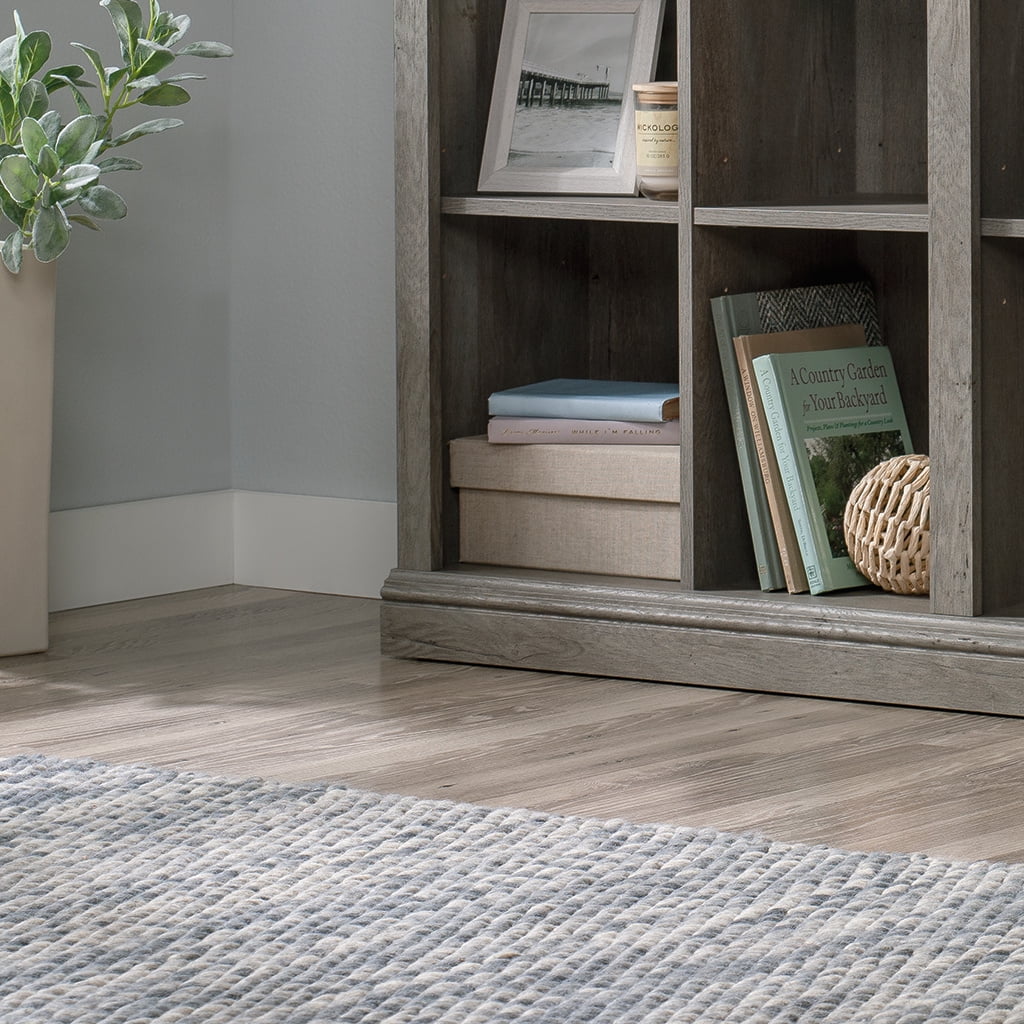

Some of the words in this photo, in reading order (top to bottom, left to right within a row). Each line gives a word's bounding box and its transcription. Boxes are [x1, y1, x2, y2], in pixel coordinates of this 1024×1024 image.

[760, 369, 768, 377] A
[791, 368, 800, 386] A
[799, 366, 845, 388] Country
[847, 359, 888, 380] Garden
[742, 374, 755, 408] WINDOW
[762, 378, 776, 410] Country
[809, 393, 837, 411] Your
[837, 385, 888, 413] Backyard
[750, 410, 758, 422] ON
[769, 412, 783, 441] Garden
[752, 424, 770, 484] WILLIAMSBURG
[776, 443, 786, 454] for
[779, 456, 790, 474] Your
[784, 476, 799, 512] Backyard
